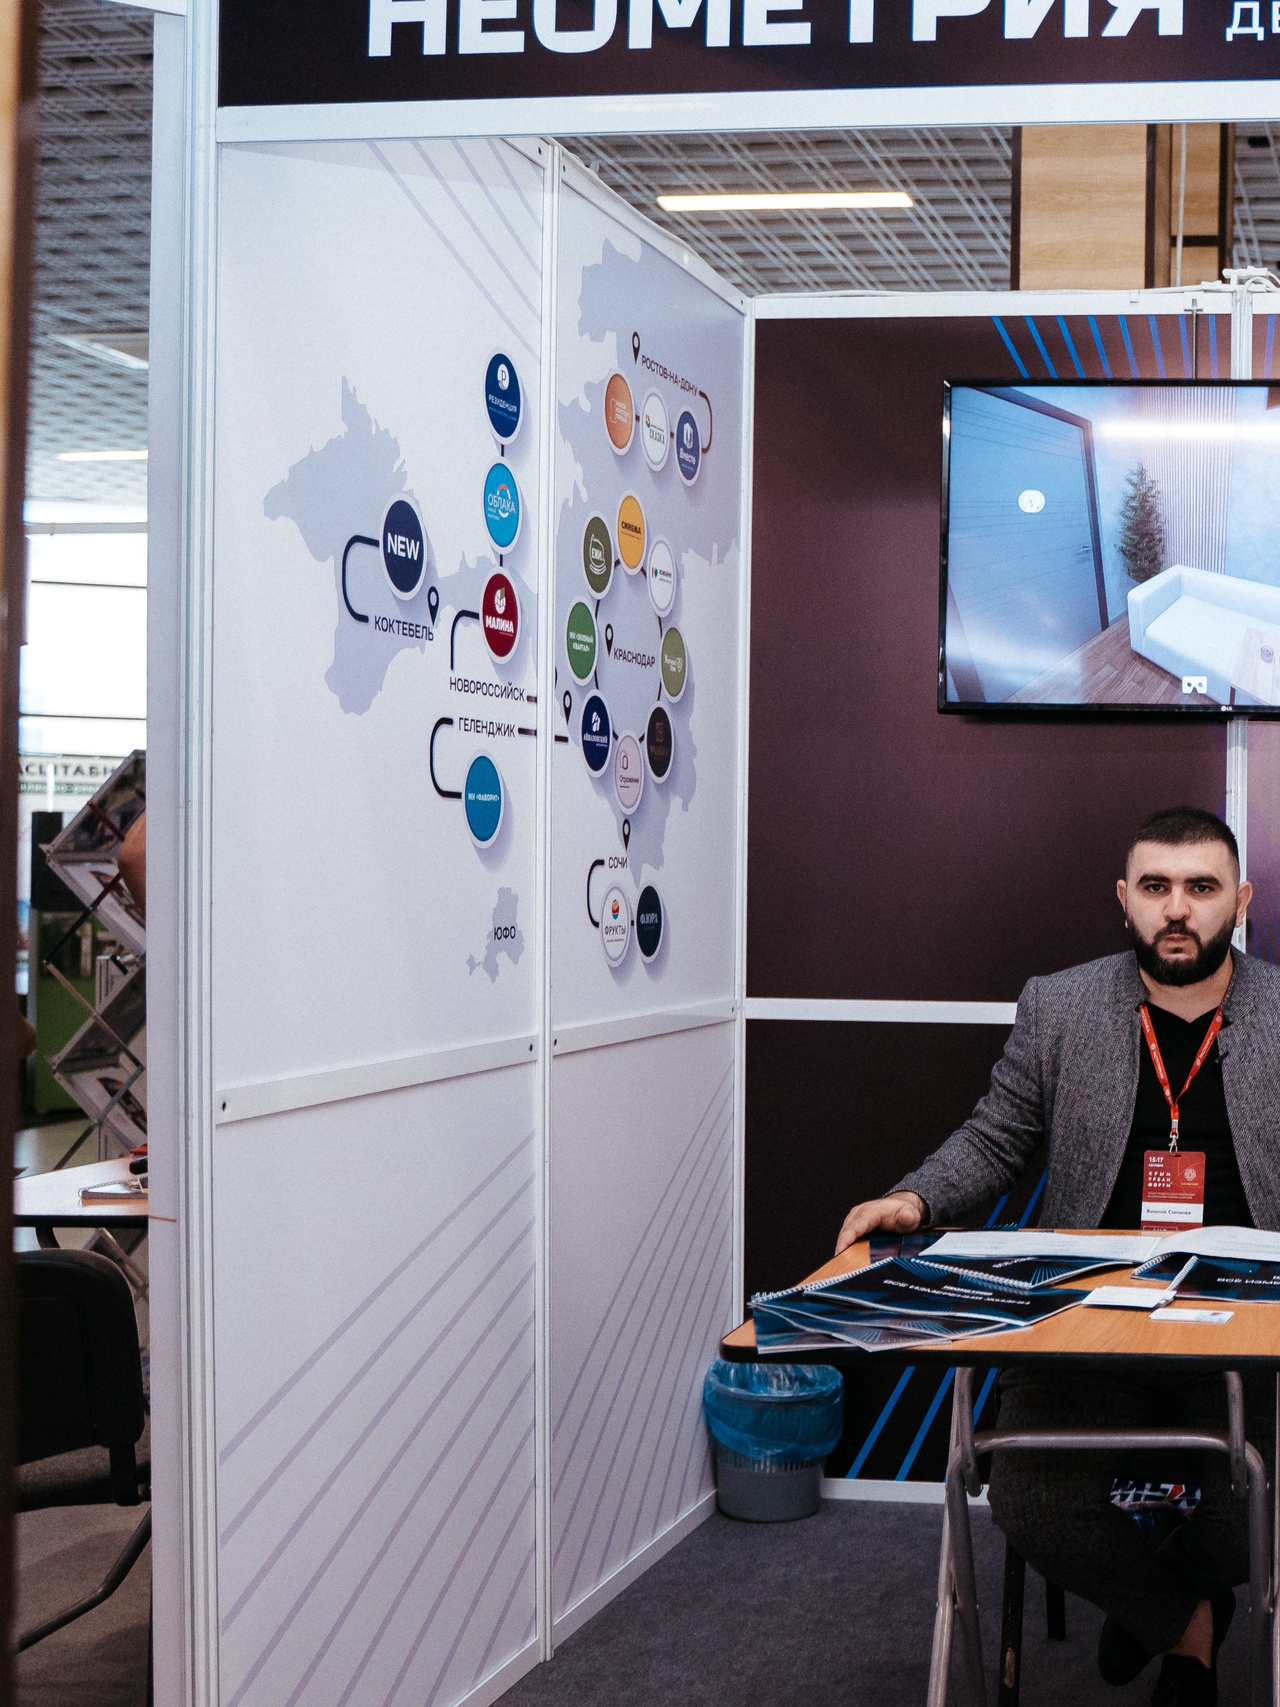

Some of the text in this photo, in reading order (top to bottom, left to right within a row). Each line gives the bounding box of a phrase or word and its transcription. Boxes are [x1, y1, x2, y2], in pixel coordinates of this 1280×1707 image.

[641, 354, 698, 396] РОСТОВ-НА-ДОНУ
[487, 493, 516, 513] ОБЛАКА
[387, 532, 420, 561] NEW
[374, 615, 434, 642] КОКТЕБЕЛЬ
[485, 614, 514, 634] МАЛИНА
[613, 647, 656, 668] КРАСНОДАР
[449, 676, 525, 702] НОВОРОССИЙСК
[458, 717, 516, 739] ГЕЛЕНДЖИК
[468, 792, 475, 801] ЖК
[608, 856, 628, 869] СОЧИ
[493, 926, 516, 941] ЮФО
[604, 925, 626, 936] ФРУКТЫ
